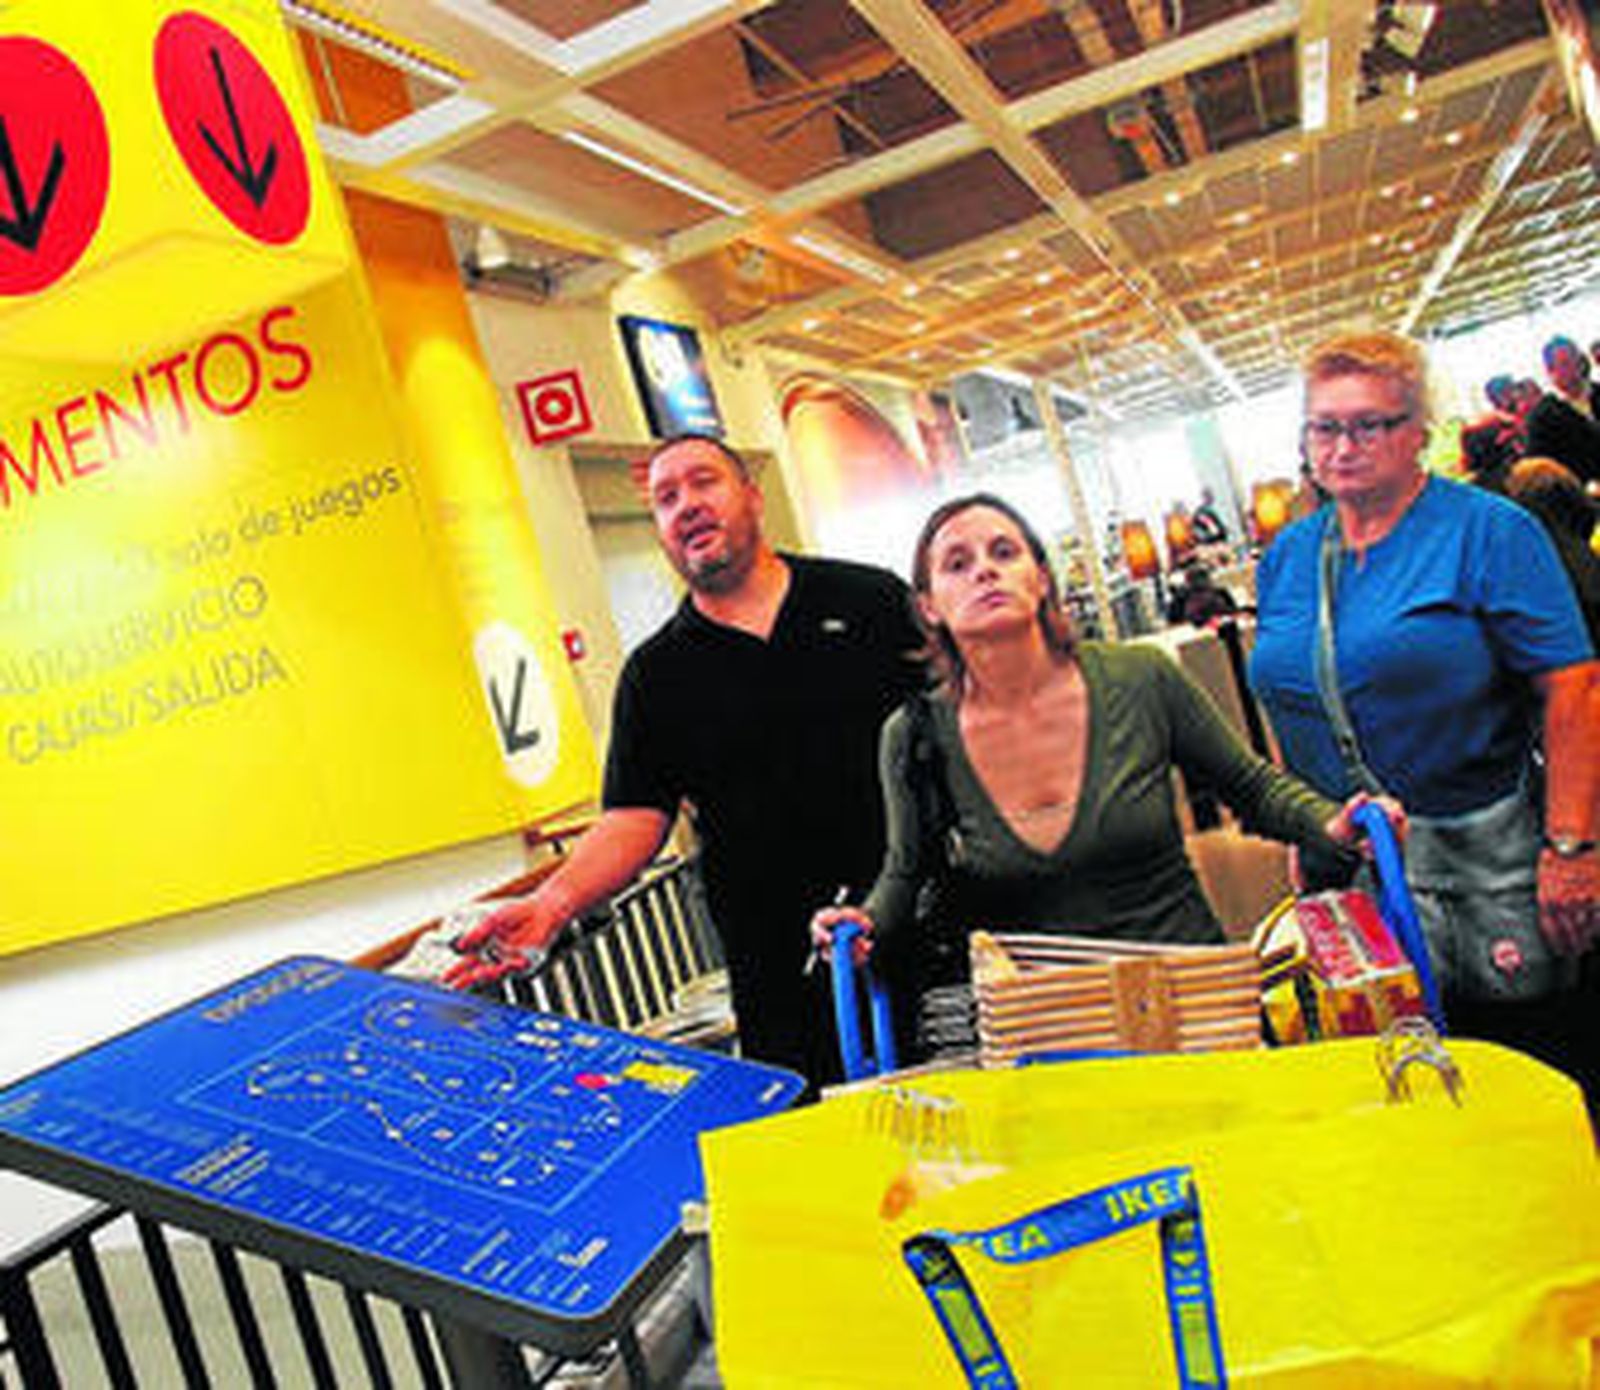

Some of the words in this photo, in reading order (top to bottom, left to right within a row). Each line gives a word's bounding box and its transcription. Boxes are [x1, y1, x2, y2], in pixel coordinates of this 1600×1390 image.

[0, 306, 313, 509] MENTOS
[238, 502, 281, 541] de
[288, 466, 401, 534] juegos
[8, 646, 289, 764] CAJAS/SALIDA
